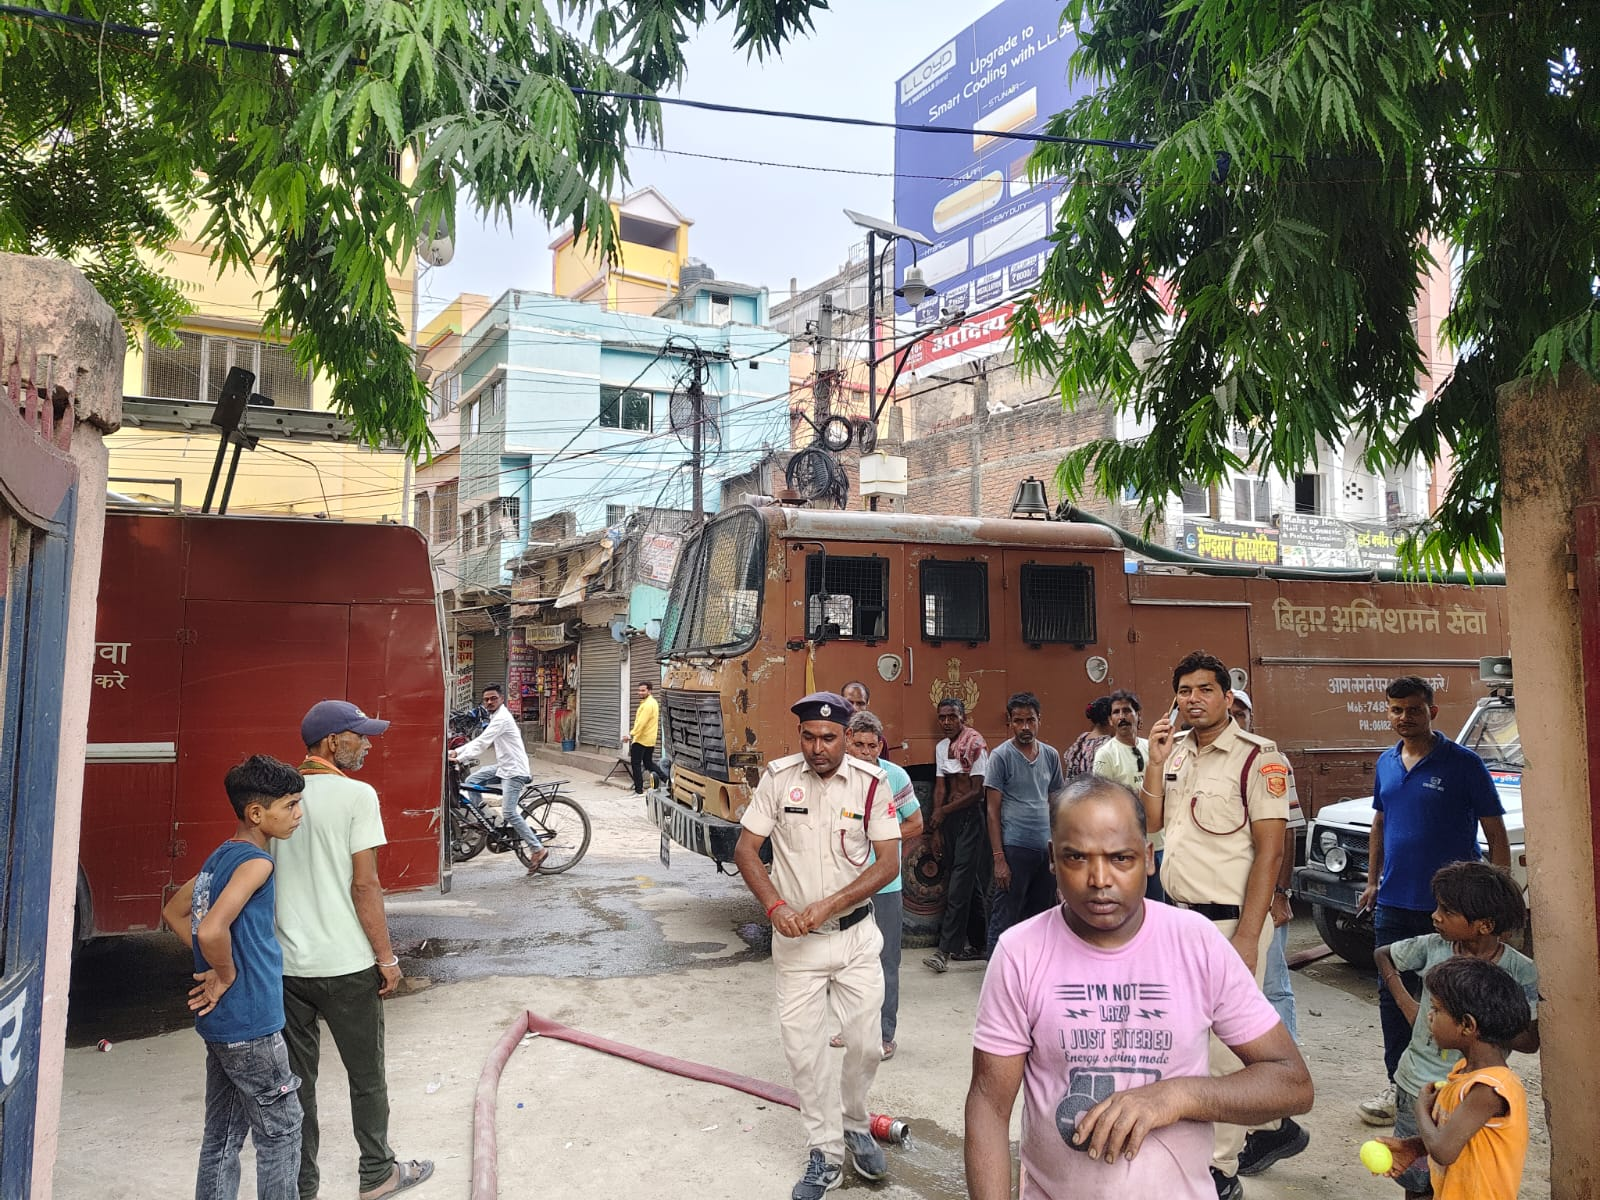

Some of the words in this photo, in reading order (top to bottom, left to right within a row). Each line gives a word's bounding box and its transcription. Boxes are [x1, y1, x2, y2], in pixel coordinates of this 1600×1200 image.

[970, 37, 1019, 76] Upgrade
[1022, 25, 1034, 41] to
[905, 49, 952, 95] LLOYD
[929, 94, 960, 123] Smart
[963, 64, 1007, 99] Cooling
[1011, 44, 1035, 68] with
[1009, 201, 1027, 216] DUTY
[931, 311, 1009, 354] आदित्य
[1272, 597, 1327, 637] बिहार
[1331, 598, 1441, 634] अग्निशमन
[1446, 603, 1488, 635] सेवा
[94, 670, 129, 690] करे
[1087, 984, 1108, 1001] I'M
[1113, 983, 1137, 1000] NOT
[1099, 1005, 1130, 1022] LAZY
[1059, 1029, 1065, 1049] I
[1070, 1029, 1106, 1049] JUST
[1111, 1029, 1172, 1050] ENTERED
[1064, 1052, 1099, 1065] Energy
[1139, 1053, 1169, 1064] mode
